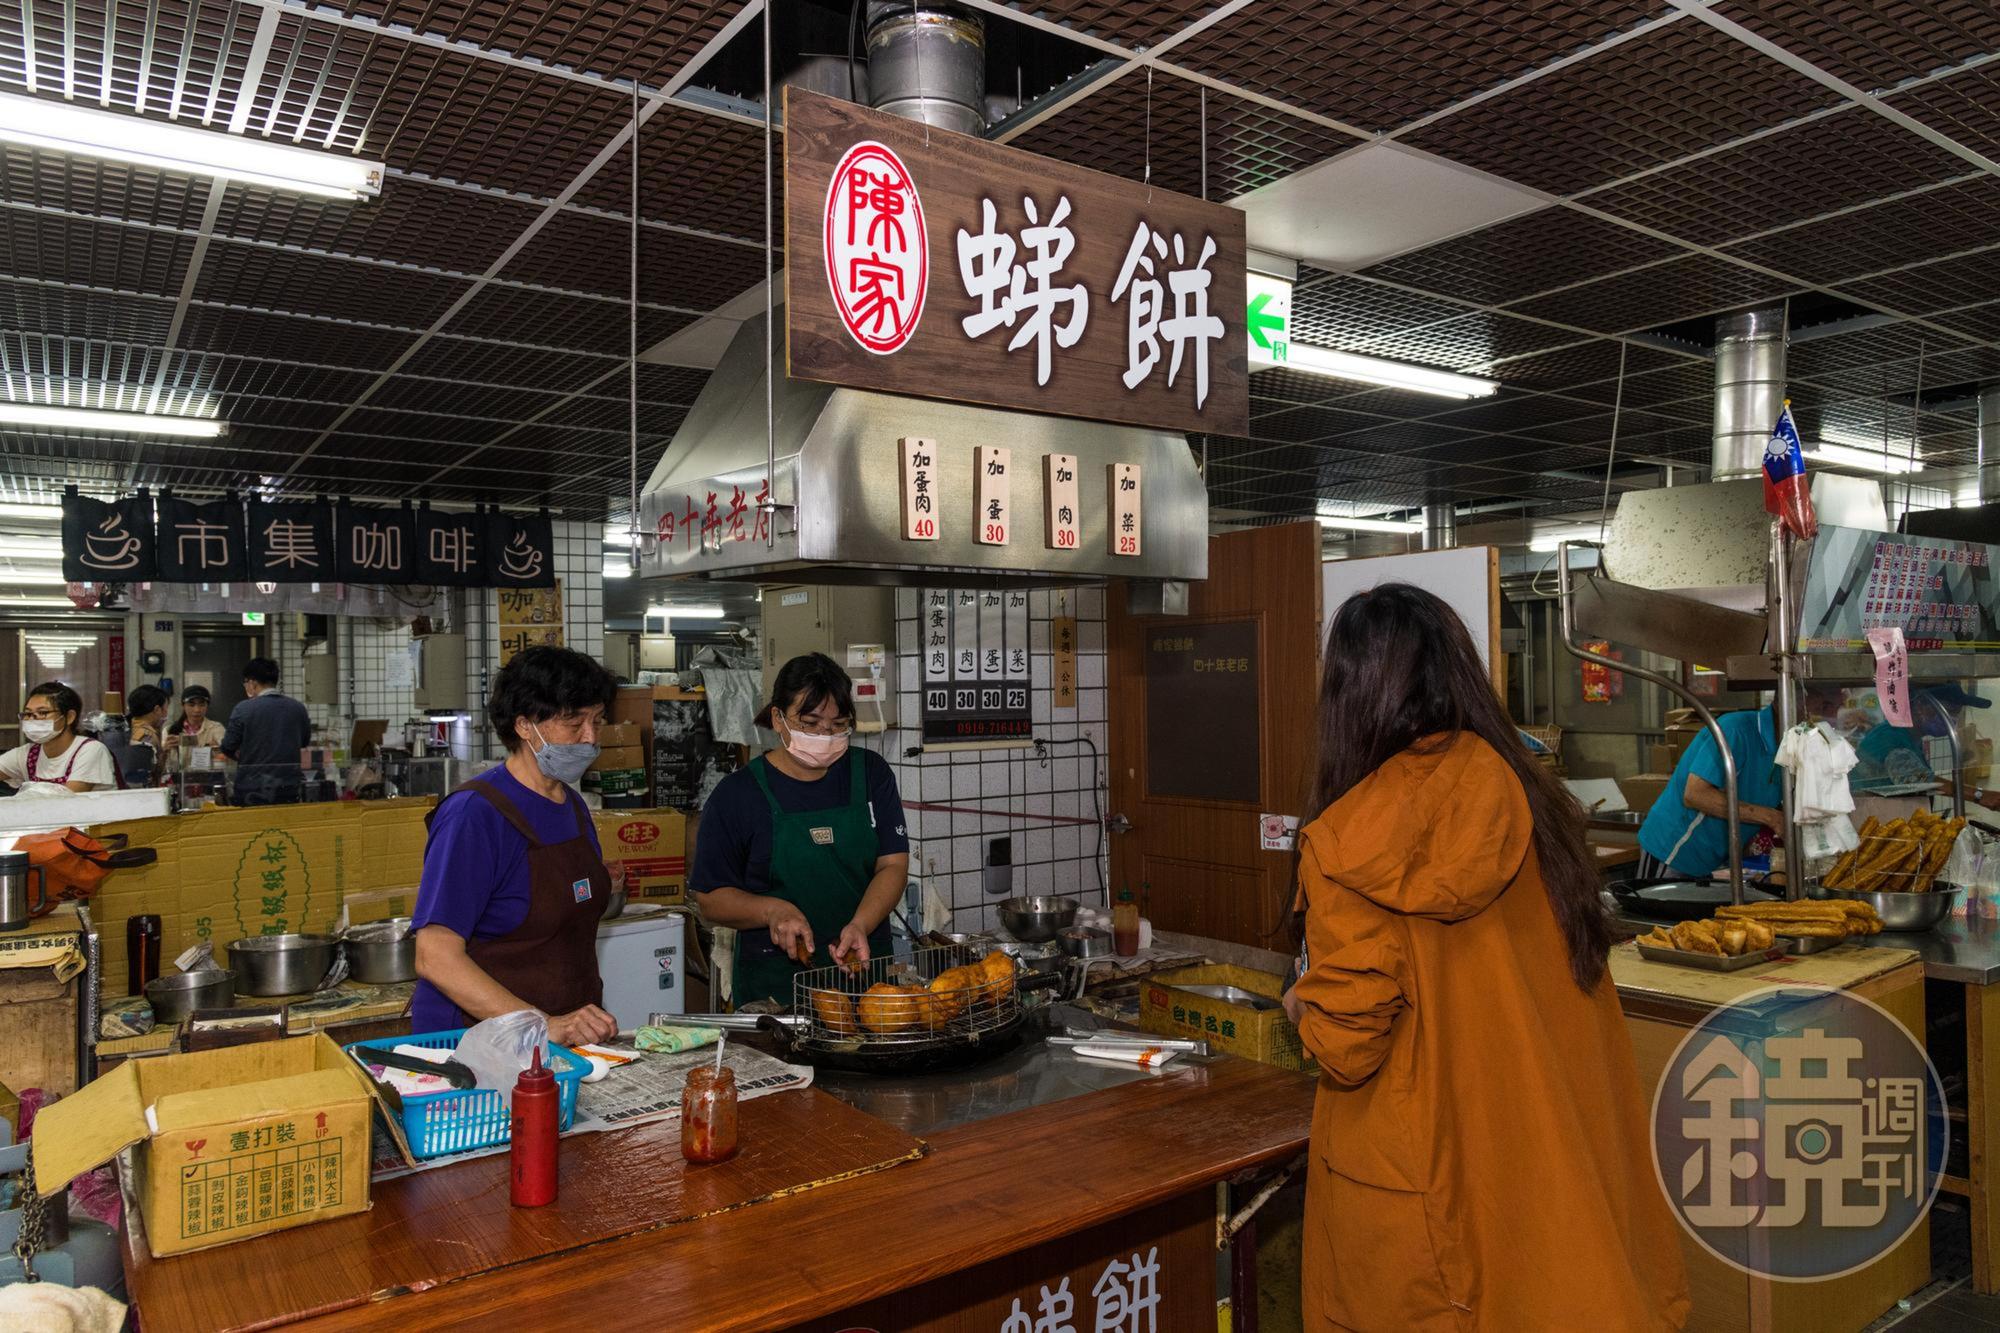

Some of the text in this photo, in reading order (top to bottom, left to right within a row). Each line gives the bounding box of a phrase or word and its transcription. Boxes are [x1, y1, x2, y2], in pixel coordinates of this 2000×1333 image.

[846, 167, 908, 335] 陳家
[912, 451, 934, 537] 加蛋肉 40
[986, 459, 1005, 542] 加蛋 30
[1056, 467, 1075, 546] 加肉 30
[1120, 476, 1137, 553] 加菜 25
[174, 517, 478, 574] 市集咖啡
[1061, 626, 1071, 697] 每週一公休
[1193, 657, 1249, 673] 四十年老店
[929, 691, 946, 709] 40
[957, 691, 974, 708] 30
[983, 691, 1000, 708] 30
[1008, 690, 1025, 707] 25
[623, 824, 655, 842] 味王
[230, 1121, 296, 1152] 壹打裝
[315, 1127, 329, 1139] UP
[211, 1178, 225, 1229] 剝皮辣椒
[281, 1165, 294, 1214] 豆豉辣椒
[303, 1161, 315, 1208] 小魚辣椒
[324, 1156, 337, 1205] 辣椒大王
